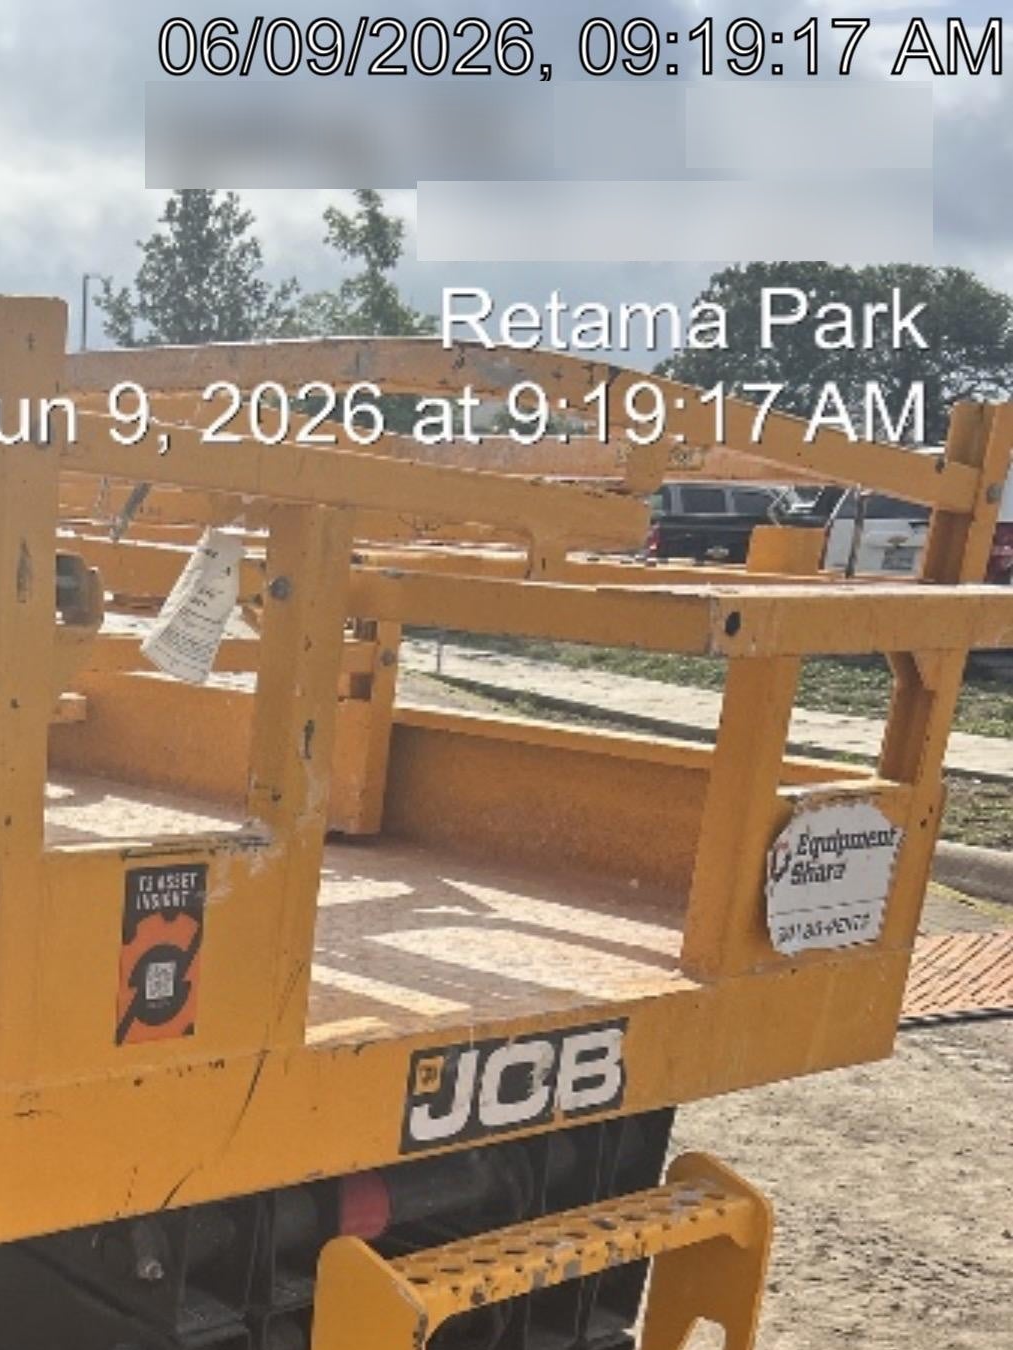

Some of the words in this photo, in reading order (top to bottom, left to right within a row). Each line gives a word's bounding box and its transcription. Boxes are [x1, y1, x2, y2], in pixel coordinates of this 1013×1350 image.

[796, 828, 897, 860] Equipment
[790, 860, 847, 886] Share
[408, 1028, 624, 1141] JCB
